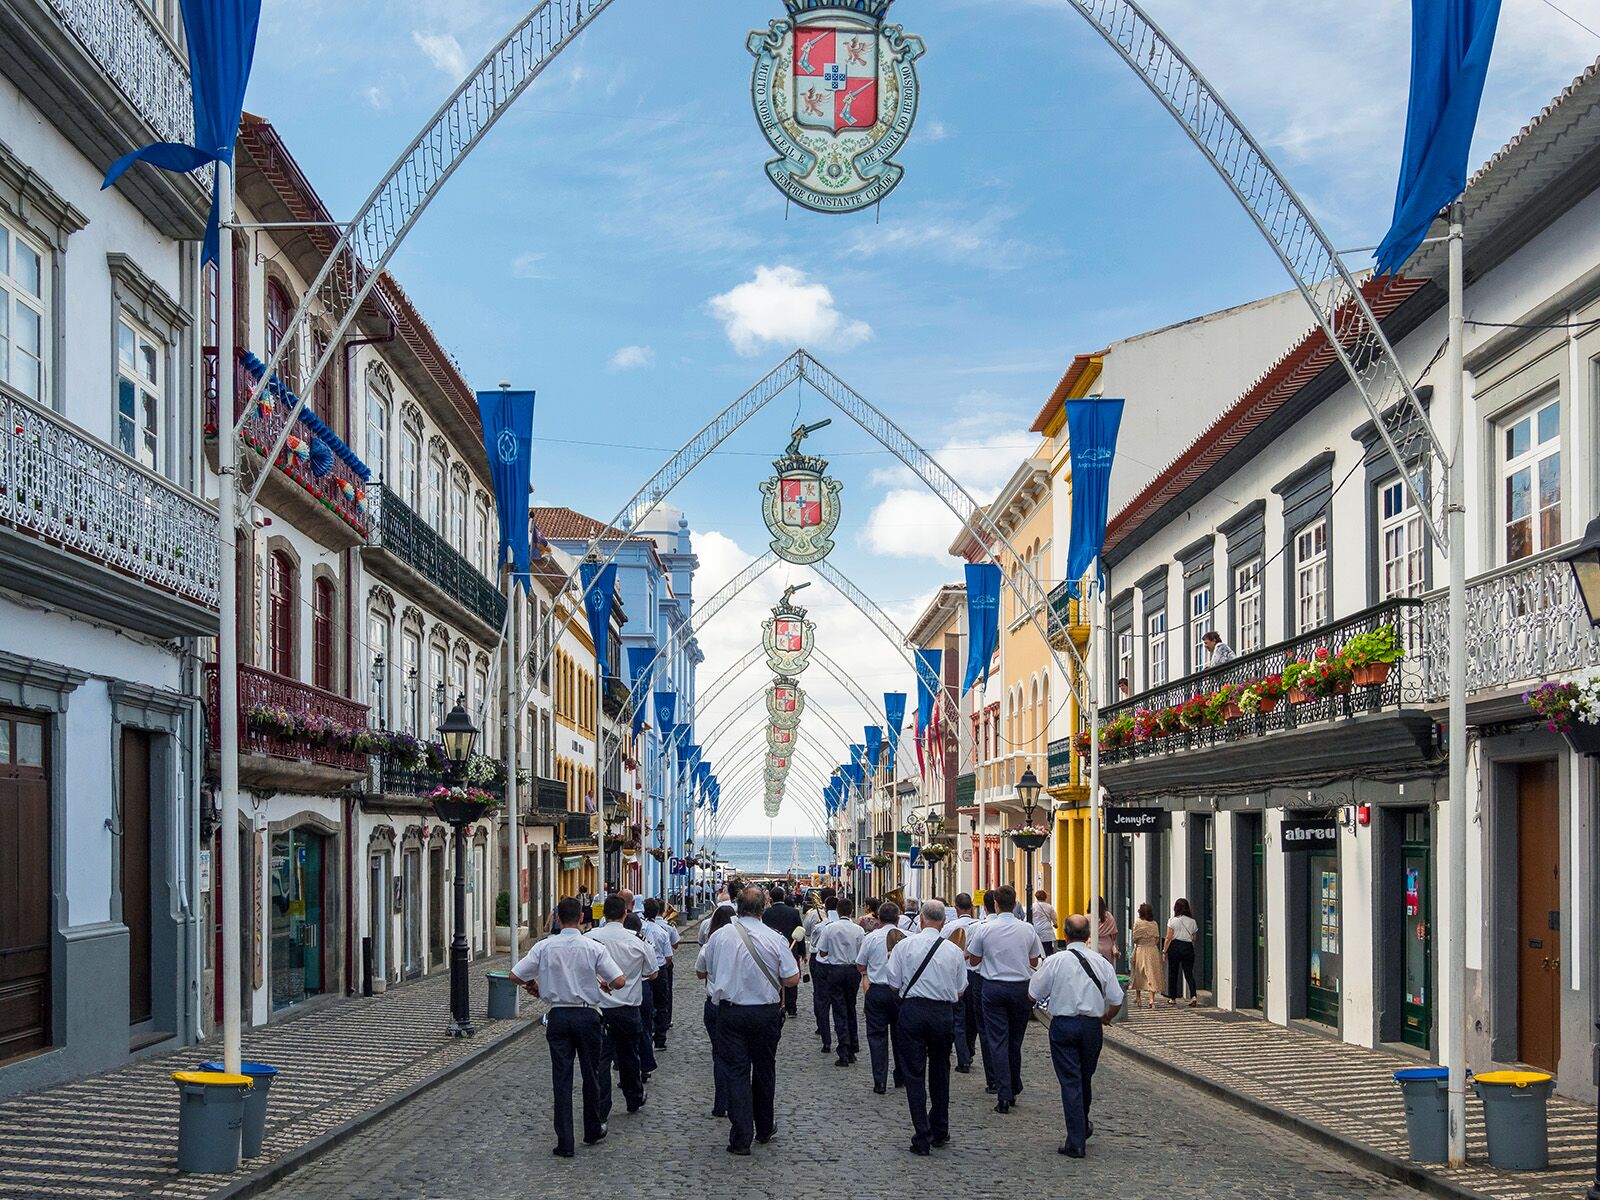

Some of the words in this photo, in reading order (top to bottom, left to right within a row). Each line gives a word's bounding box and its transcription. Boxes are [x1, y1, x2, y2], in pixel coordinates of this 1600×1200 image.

[901, 66, 914, 115] HEROISMO
[757, 62, 770, 96] MUITO
[774, 134, 795, 158] LEAL
[797, 154, 806, 164] E
[897, 114, 909, 130] DO
[877, 130, 902, 157] ANGRA
[863, 153, 877, 166] DE
[774, 170, 805, 199] SEMPRE
[807, 193, 863, 207] CONSTANTE
[865, 173, 895, 200] CIDADE
[1114, 814, 1156, 827] Jennyfer
[1285, 827, 1336, 841] abreu
[671, 859, 678, 873] P
